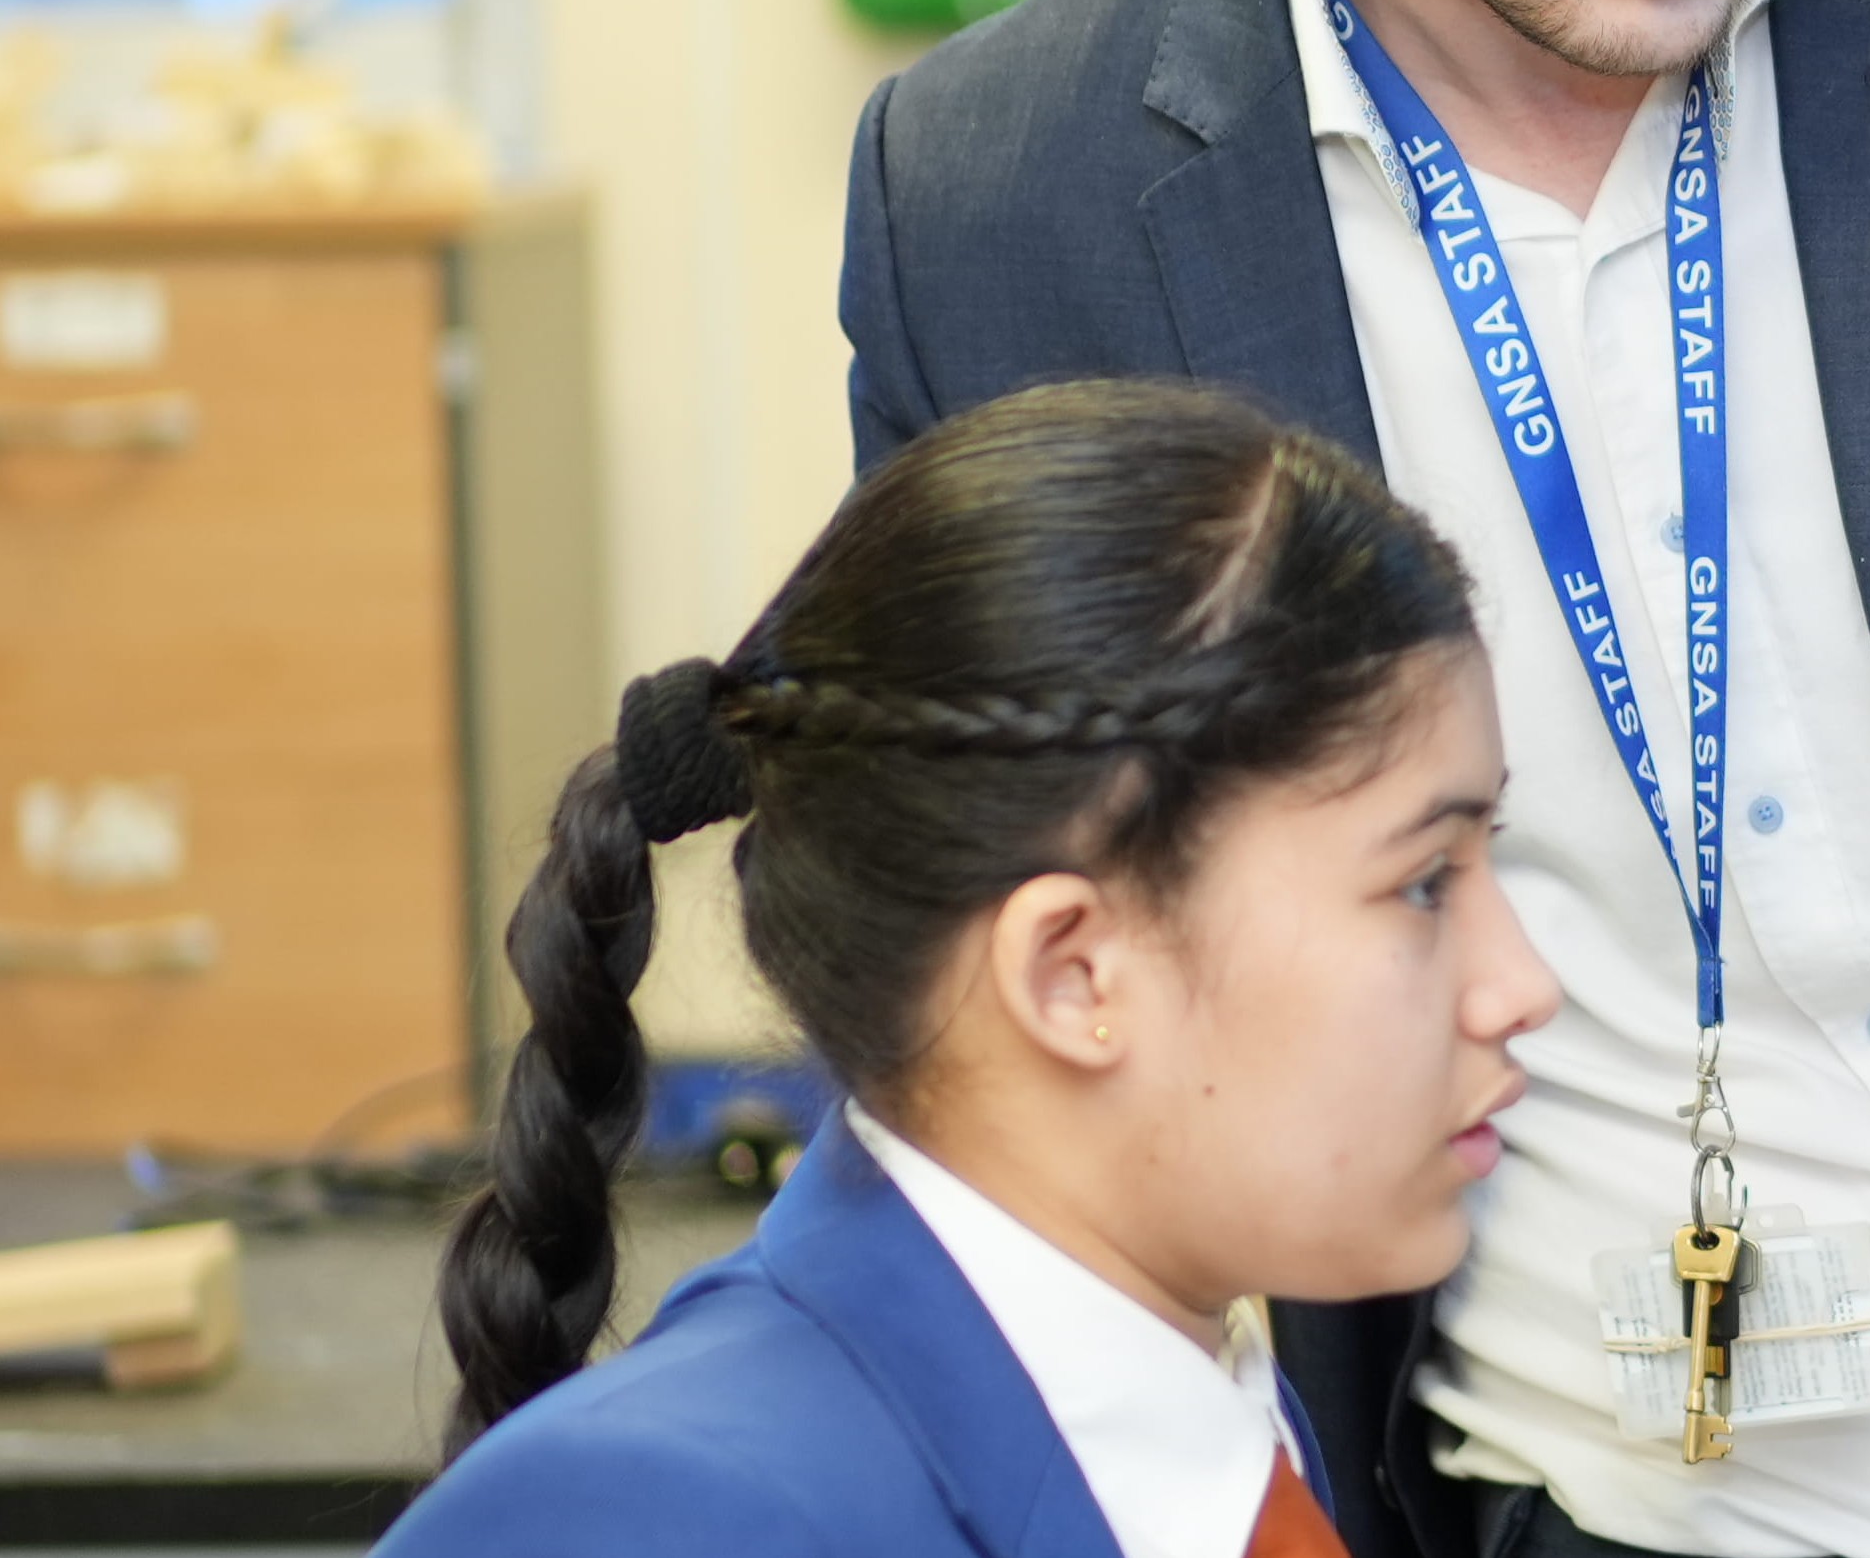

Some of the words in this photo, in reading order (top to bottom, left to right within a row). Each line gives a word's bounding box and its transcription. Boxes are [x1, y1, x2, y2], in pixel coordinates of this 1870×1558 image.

[1401, 134, 1496, 291] STAFF
[1674, 84, 1709, 245] GNSA
[1473, 296, 1554, 456] GNSA
[1676, 259, 1716, 435] STAFF
[1563, 570, 1640, 738] STAFF
[1689, 556, 1718, 717] GNSA
[1694, 733, 1718, 910] STAFF
